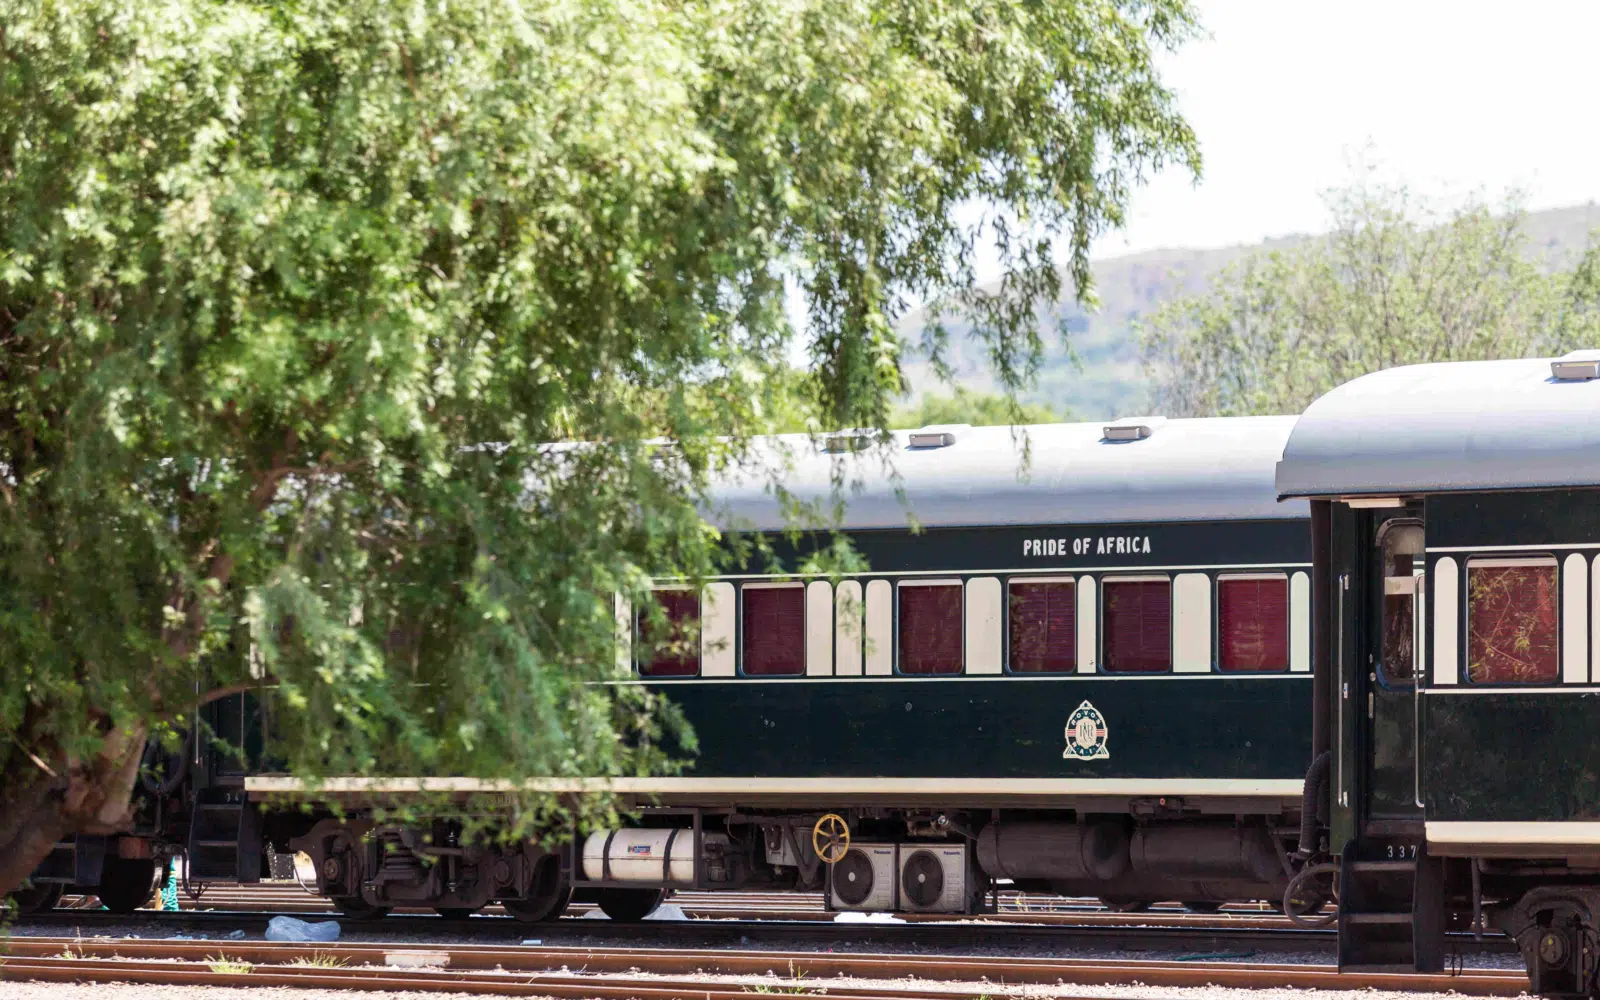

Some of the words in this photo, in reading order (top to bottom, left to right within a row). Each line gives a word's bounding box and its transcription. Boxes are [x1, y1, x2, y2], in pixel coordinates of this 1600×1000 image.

[1023, 538, 1067, 556] PRIDE
[1072, 537, 1091, 555] OF
[1096, 536, 1151, 554] AFRICA
[1387, 844, 1417, 858] 337
